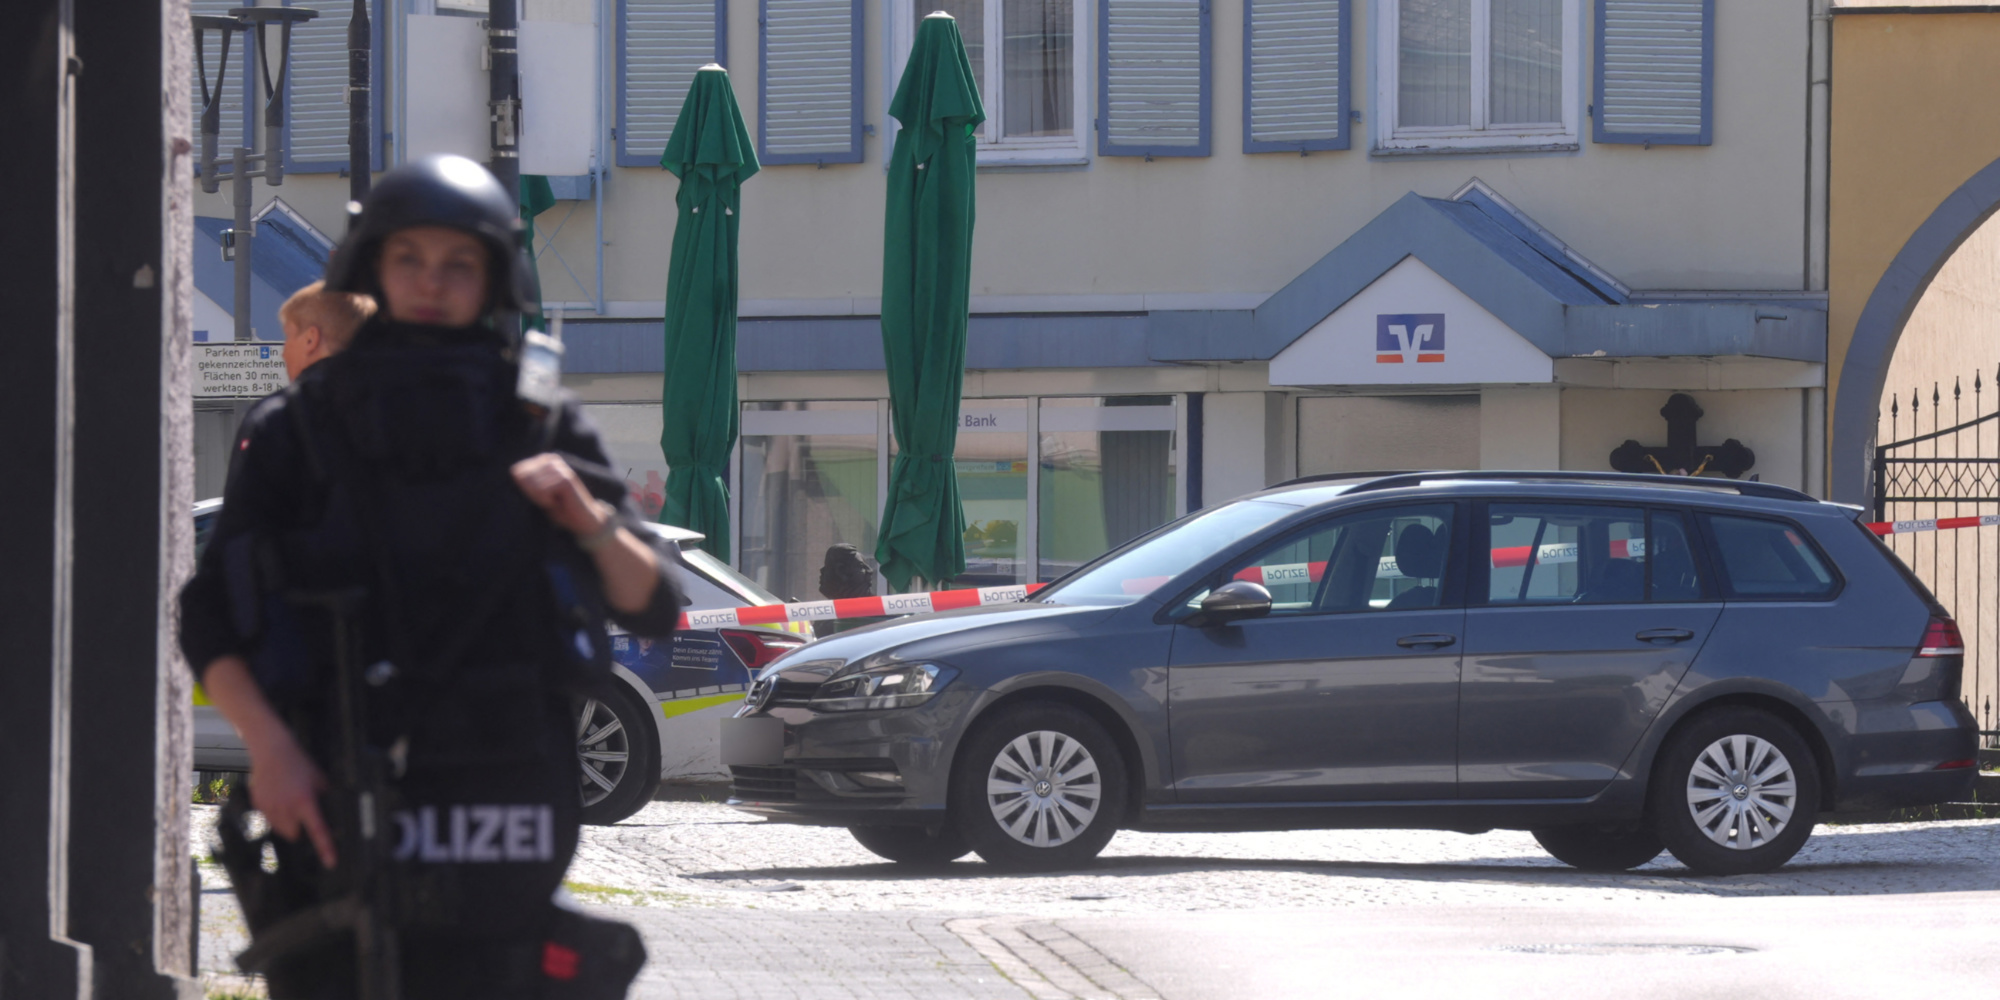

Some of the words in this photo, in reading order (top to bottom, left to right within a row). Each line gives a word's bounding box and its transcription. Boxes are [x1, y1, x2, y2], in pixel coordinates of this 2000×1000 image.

[205, 348, 240, 357] Parken
[243, 347, 259, 357] mit
[269, 347, 278, 356] in
[198, 360, 286, 371] gekennzeichneten
[203, 371, 242, 380] Flächen
[245, 371, 257, 380] 30
[260, 372, 281, 380] min.
[203, 383, 248, 394] werktags
[252, 383, 272, 392] 8-18
[965, 413, 997, 427] Bank
[394, 805, 553, 862] OLIZEI
